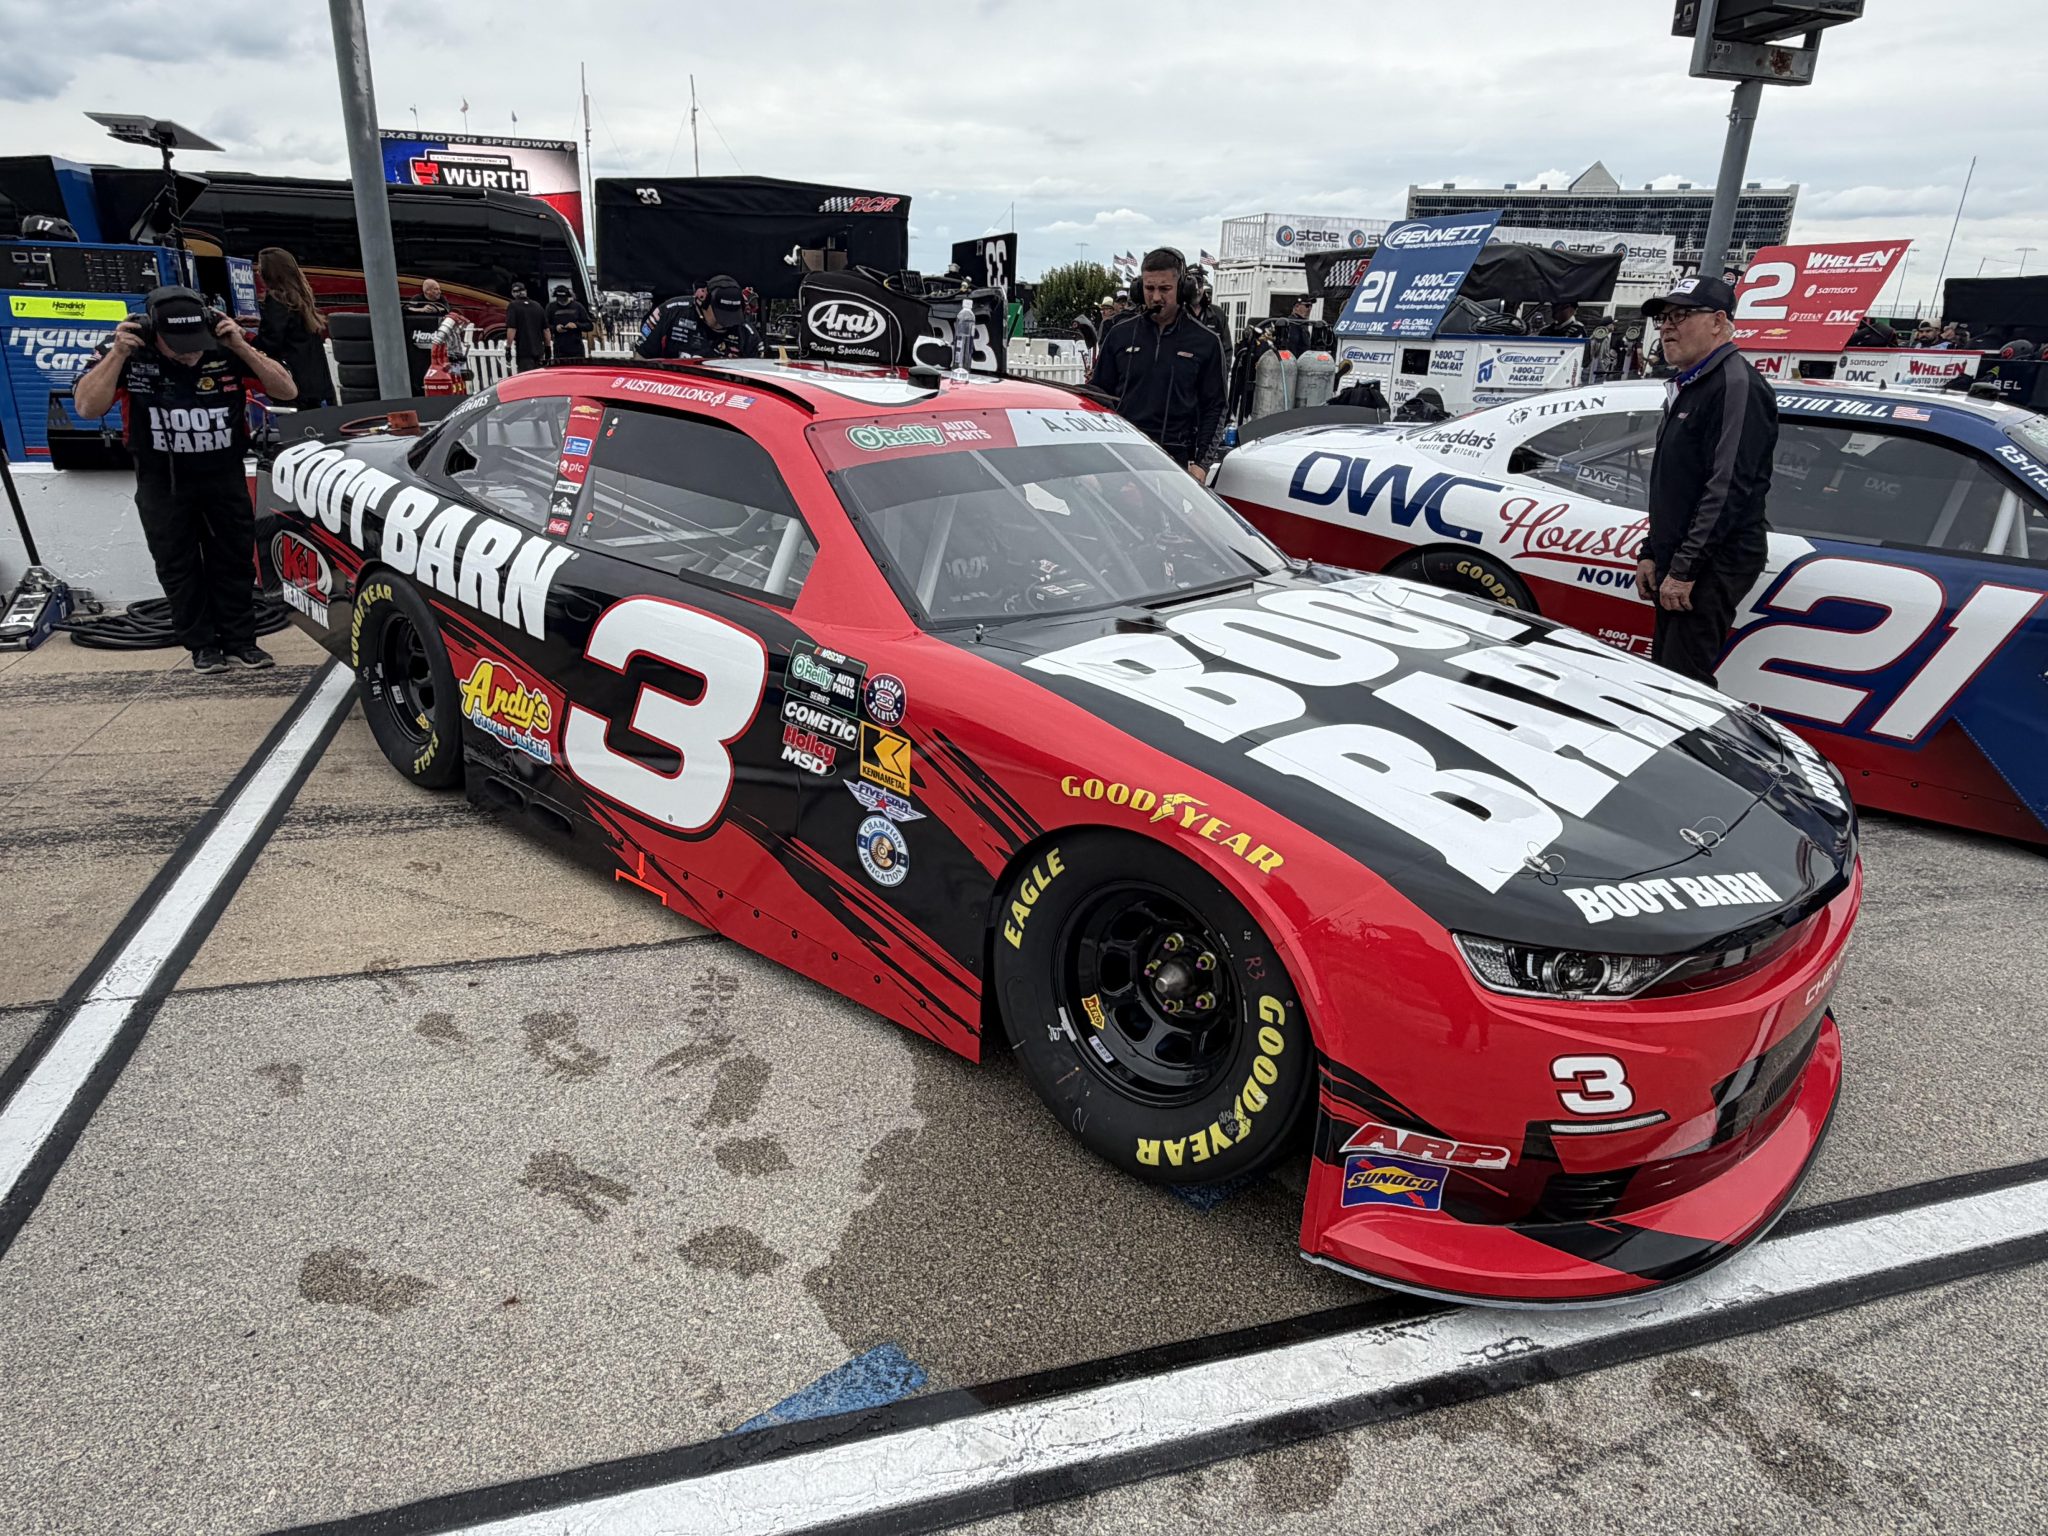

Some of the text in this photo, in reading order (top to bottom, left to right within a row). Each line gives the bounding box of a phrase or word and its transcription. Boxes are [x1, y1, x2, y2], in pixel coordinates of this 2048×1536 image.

[379, 131, 561, 149] EXAS MOTOR SPEEDWAY
[636, 188, 662, 205] 33
[36, 219, 53, 231] 17
[1296, 229, 1340, 242] state
[1392, 224, 1492, 245] BENNETT
[1627, 246, 1667, 258] state
[1806, 247, 1897, 269] WHELEN
[1354, 270, 1398, 313] 21
[1734, 261, 1796, 320] 2
[1816, 286, 1859, 294] samsara
[15, 302, 86, 310] 17 Hendrick
[1825, 310, 1865, 322] DWC
[811, 304, 876, 333] Arai
[809, 341, 835, 354] Racing
[1346, 351, 1394, 361] BENNETT
[1504, 355, 1562, 363] BENNETT
[1431, 360, 1464, 371] PACK-RAT
[1845, 370, 1876, 382] DWC
[1910, 360, 1968, 376] WHELEN
[623, 378, 714, 402] AUSTINDILLON3
[1508, 374, 1545, 383] PACK-RAT
[1395, 391, 1410, 401] DWC
[1537, 396, 1608, 417] TITAN
[149, 406, 230, 431] BOOT
[1831, 399, 1889, 418] HILL
[151, 428, 231, 453] BARN
[848, 420, 978, 449] O'Reilly AUTO
[945, 429, 992, 443] PARTS
[1419, 429, 1496, 450] Cheddar's
[1452, 447, 1483, 459] KITCHEN
[568, 462, 585, 473] ptc
[1288, 451, 1505, 545] DWC
[271, 440, 575, 642] BOOT BARN
[1577, 566, 1637, 590] NOW
[351, 583, 393, 668] GOODYEAR
[1022, 575, 1532, 745] BOOT
[1713, 556, 2046, 742] 21
[793, 655, 856, 691] O'Reilly AUTO
[461, 661, 551, 730] Andy's
[809, 691, 831, 705] SERIES
[831, 681, 856, 700] PARTS
[873, 680, 902, 699] NASCAR
[563, 595, 769, 833] 3
[784, 701, 858, 742] COMETIC
[869, 702, 899, 722] SALUTES
[474, 707, 552, 763] Frozen Custard
[782, 724, 837, 767] Holley
[413, 729, 440, 775] EAGLE
[781, 745, 828, 775] MSD
[1245, 628, 1727, 895] BARN
[862, 765, 907, 792] KENNAMETAL
[858, 784, 884, 800] FIVE
[885, 795, 909, 814] STAR
[863, 822, 903, 849] CHAMPION
[1061, 774, 1285, 875] GOODYEAR
[862, 852, 904, 884] IRRIGATION
[1003, 847, 1066, 950] EAGLE
[1563, 870, 1784, 925] BOOT BARN
[1244, 956, 1266, 980] R3
[1086, 1000, 1102, 1024] AERO
[1135, 994, 1287, 1167] GOODYEAR
[1551, 1053, 1636, 1115] 3
[1339, 1121, 1512, 1170] ARP
[1350, 1172, 1437, 1192] SUNOCO
